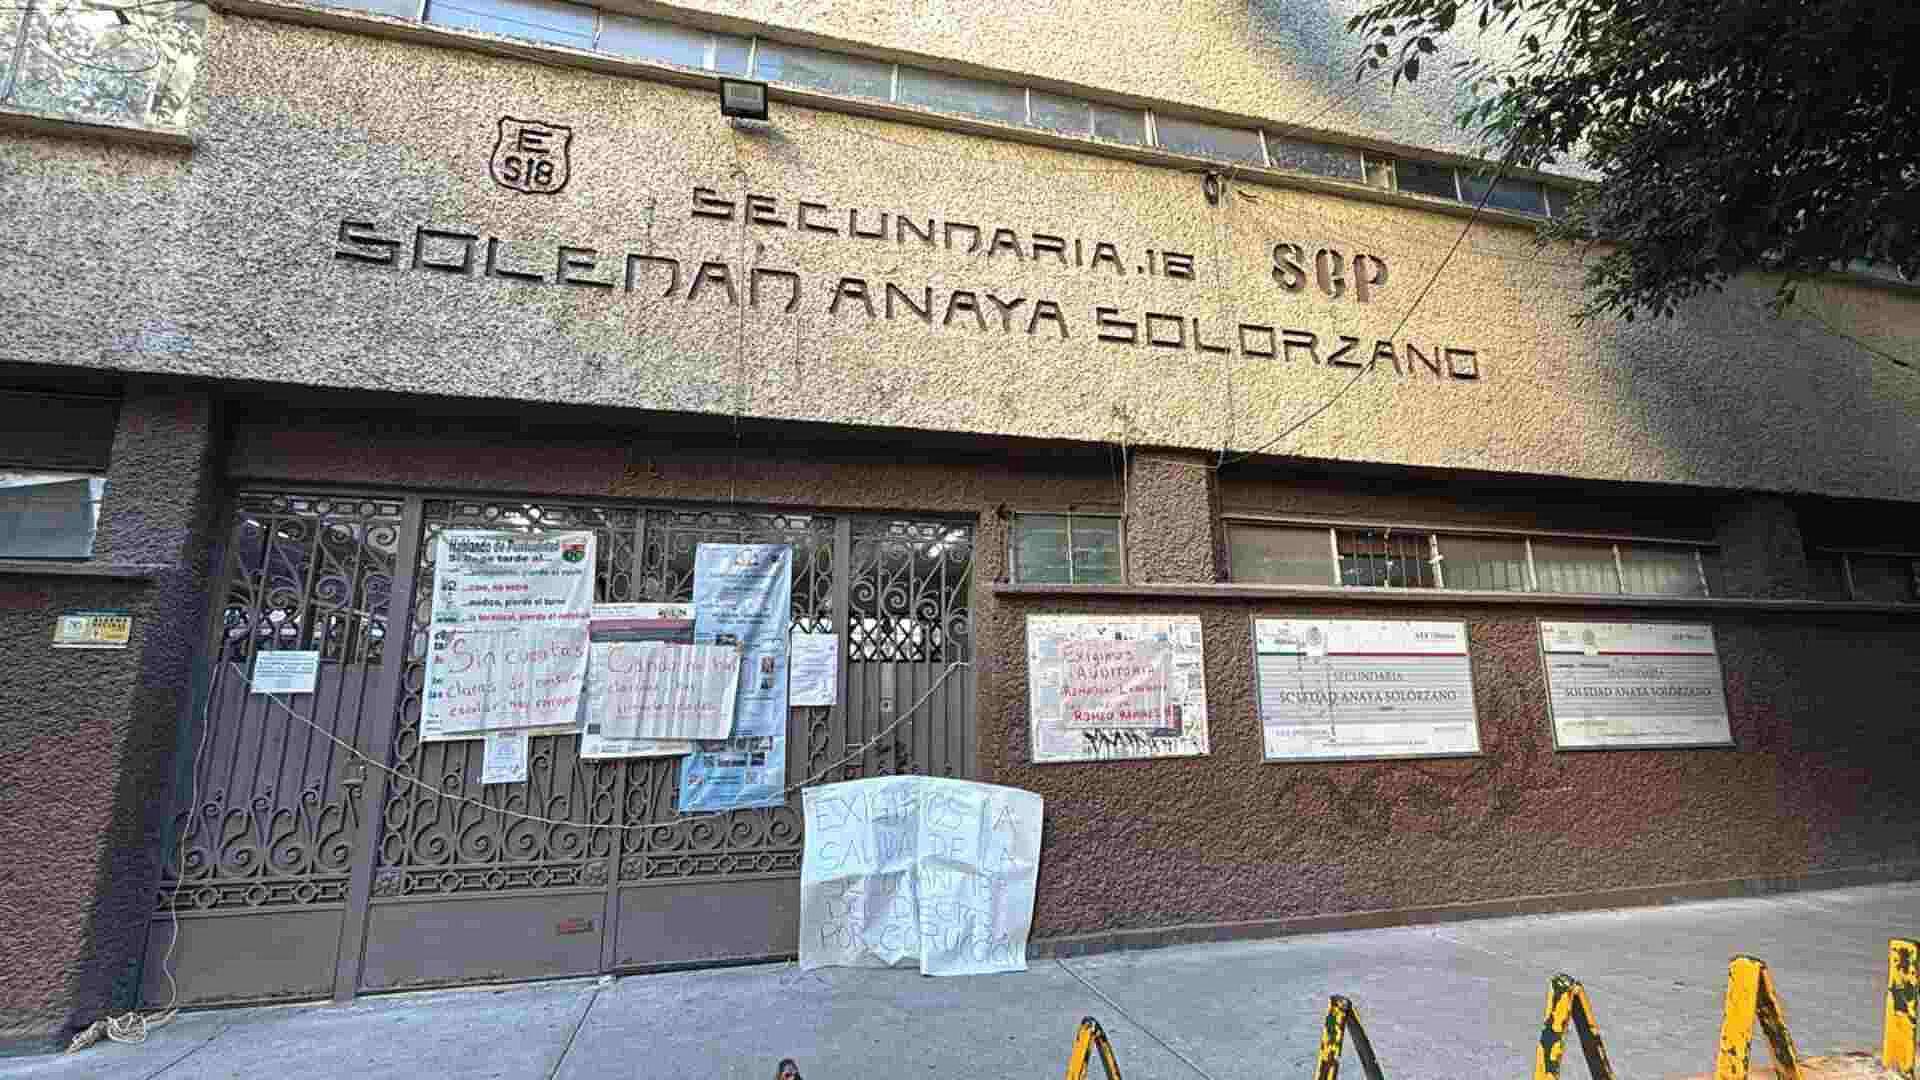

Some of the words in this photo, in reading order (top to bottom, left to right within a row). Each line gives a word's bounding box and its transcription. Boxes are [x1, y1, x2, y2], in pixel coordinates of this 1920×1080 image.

[517, 128, 553, 154] E
[502, 155, 555, 187] S18
[828, 276, 1070, 339] ANAYA
[1095, 305, 1481, 382] SOLORZANO
[1341, 689, 1384, 703] ANAYA
